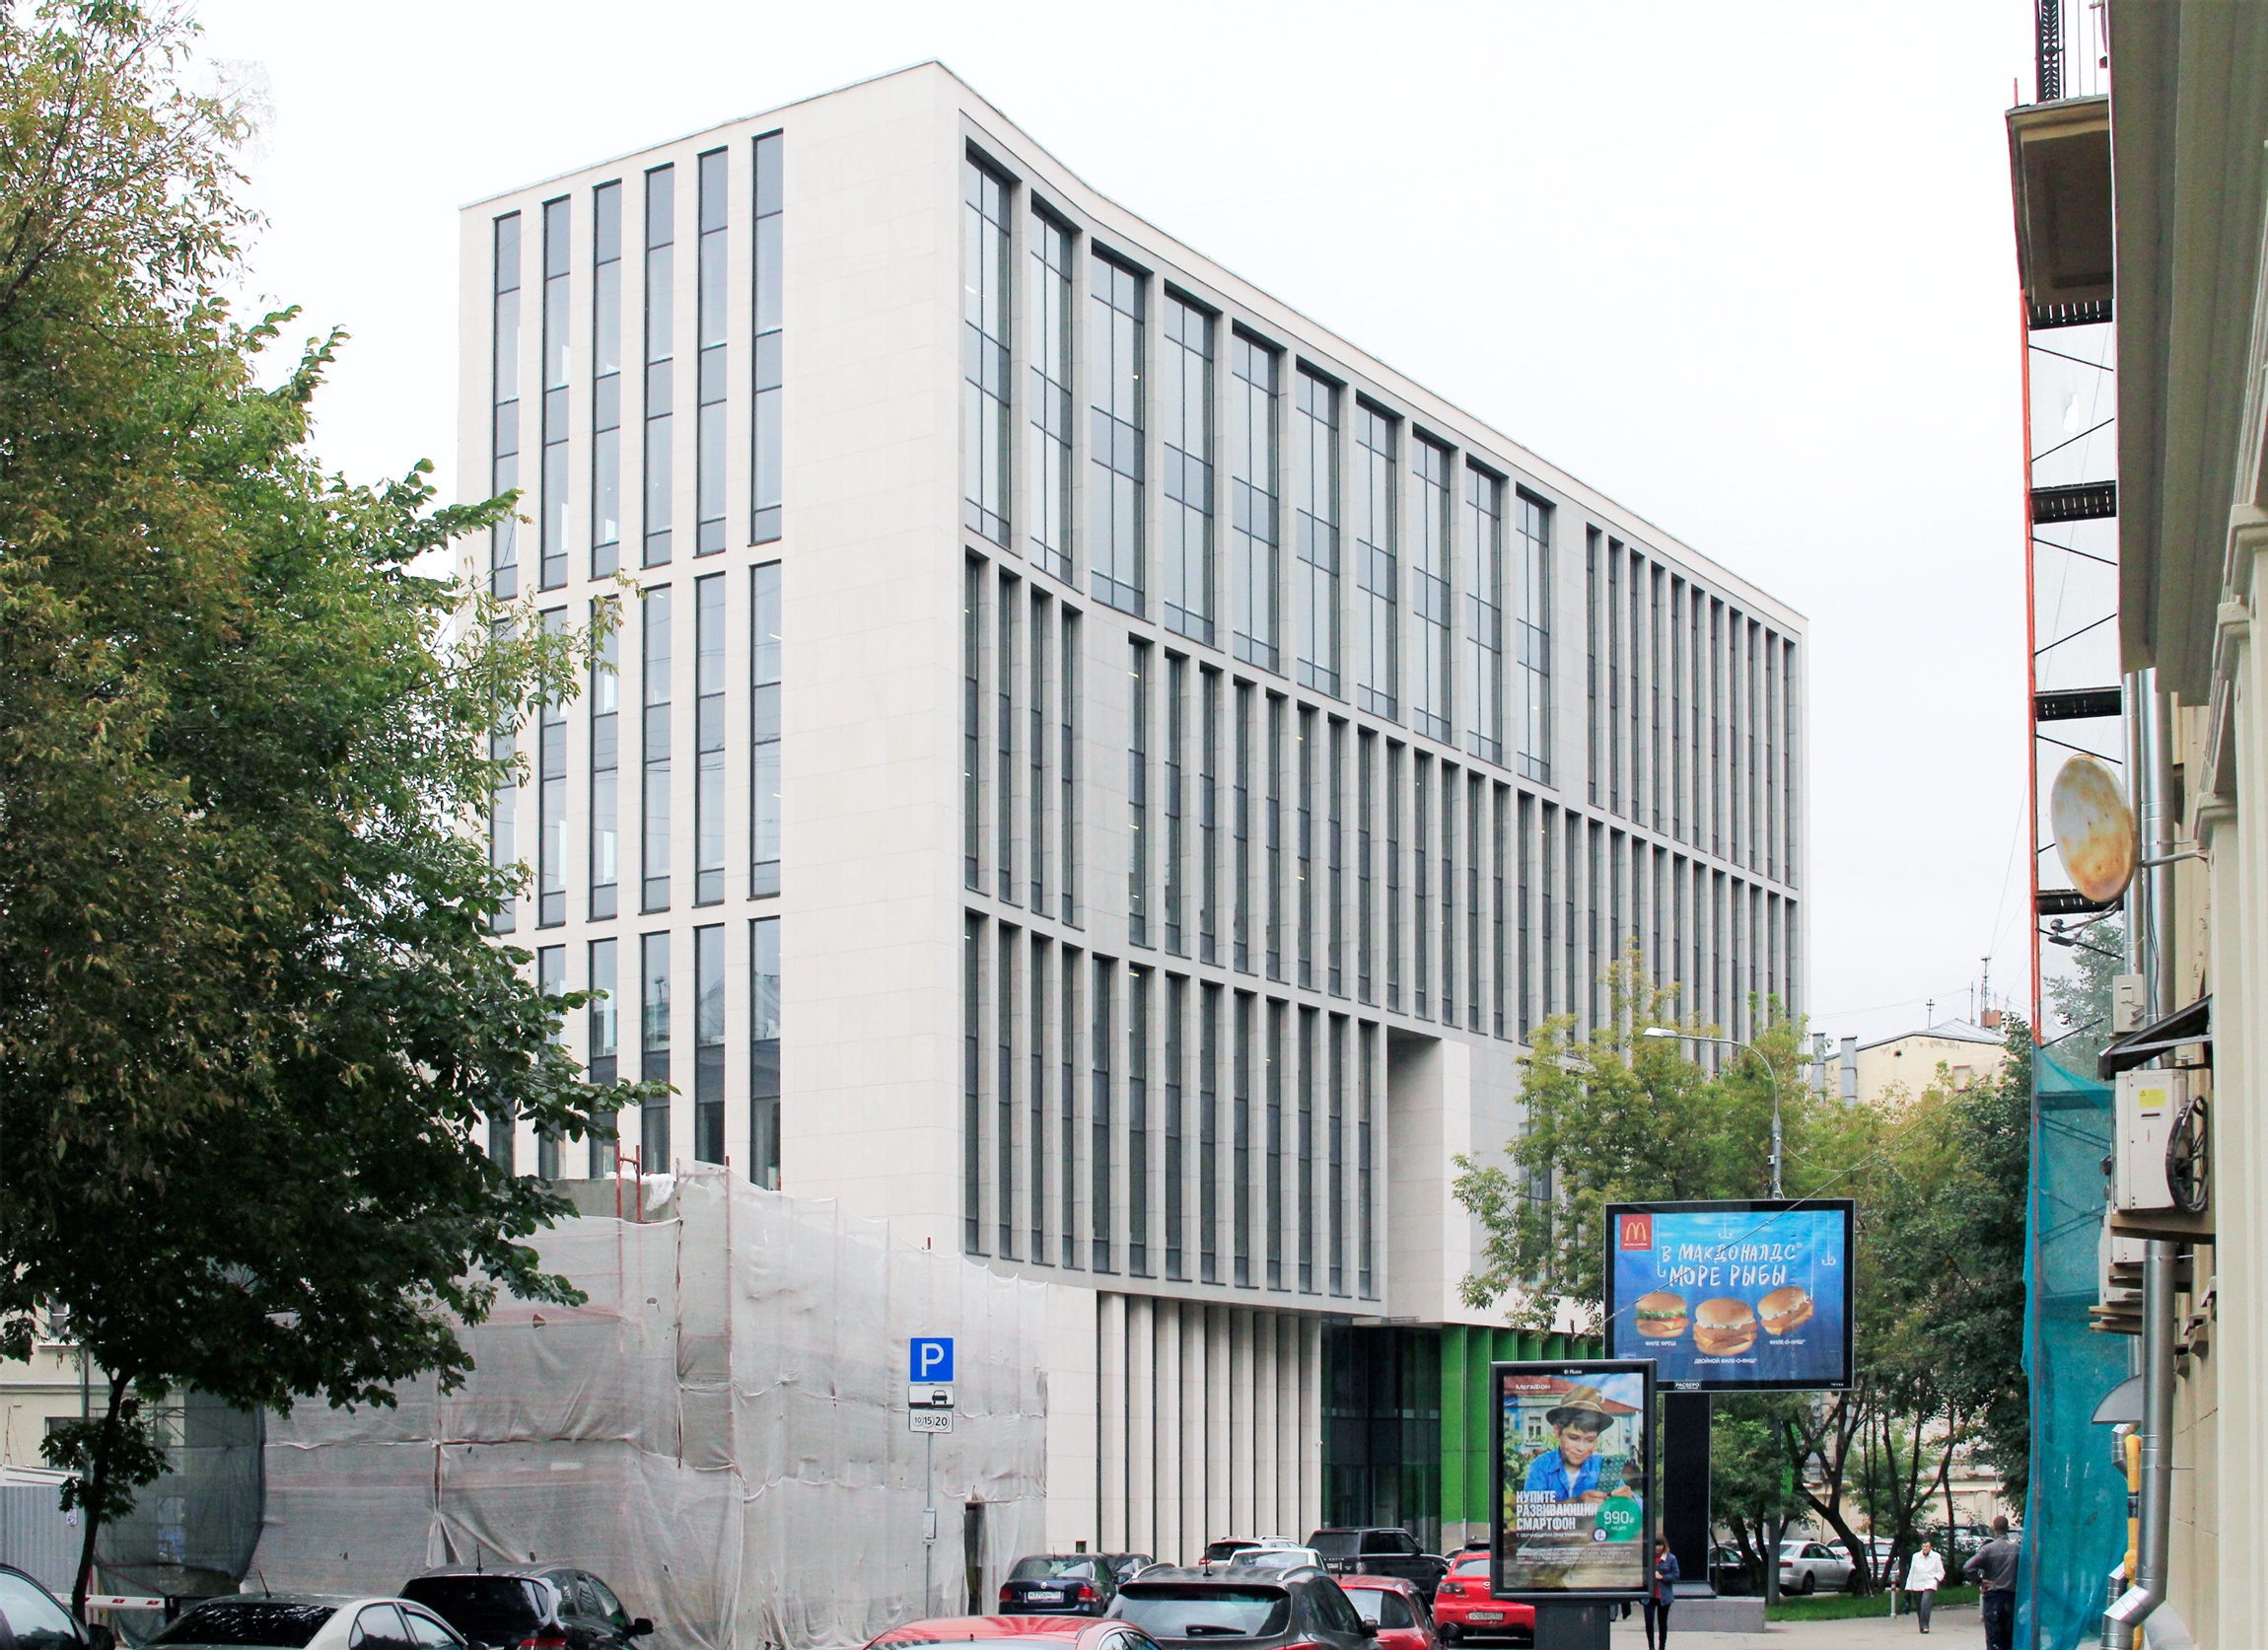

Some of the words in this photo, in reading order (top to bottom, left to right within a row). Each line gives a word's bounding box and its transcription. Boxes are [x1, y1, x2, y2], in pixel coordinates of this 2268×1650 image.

[1662, 1245, 1672, 1262] В
[1668, 1264, 1722, 1287] МОРЕ
[1730, 1263, 1787, 1287] РЫБЫ
[921, 1342, 945, 1377] P
[935, 1416, 948, 1426] 20
[1516, 1490, 1556, 1503] КУПИТЕ
[1516, 1517, 1576, 1530] СМАРТФОН
